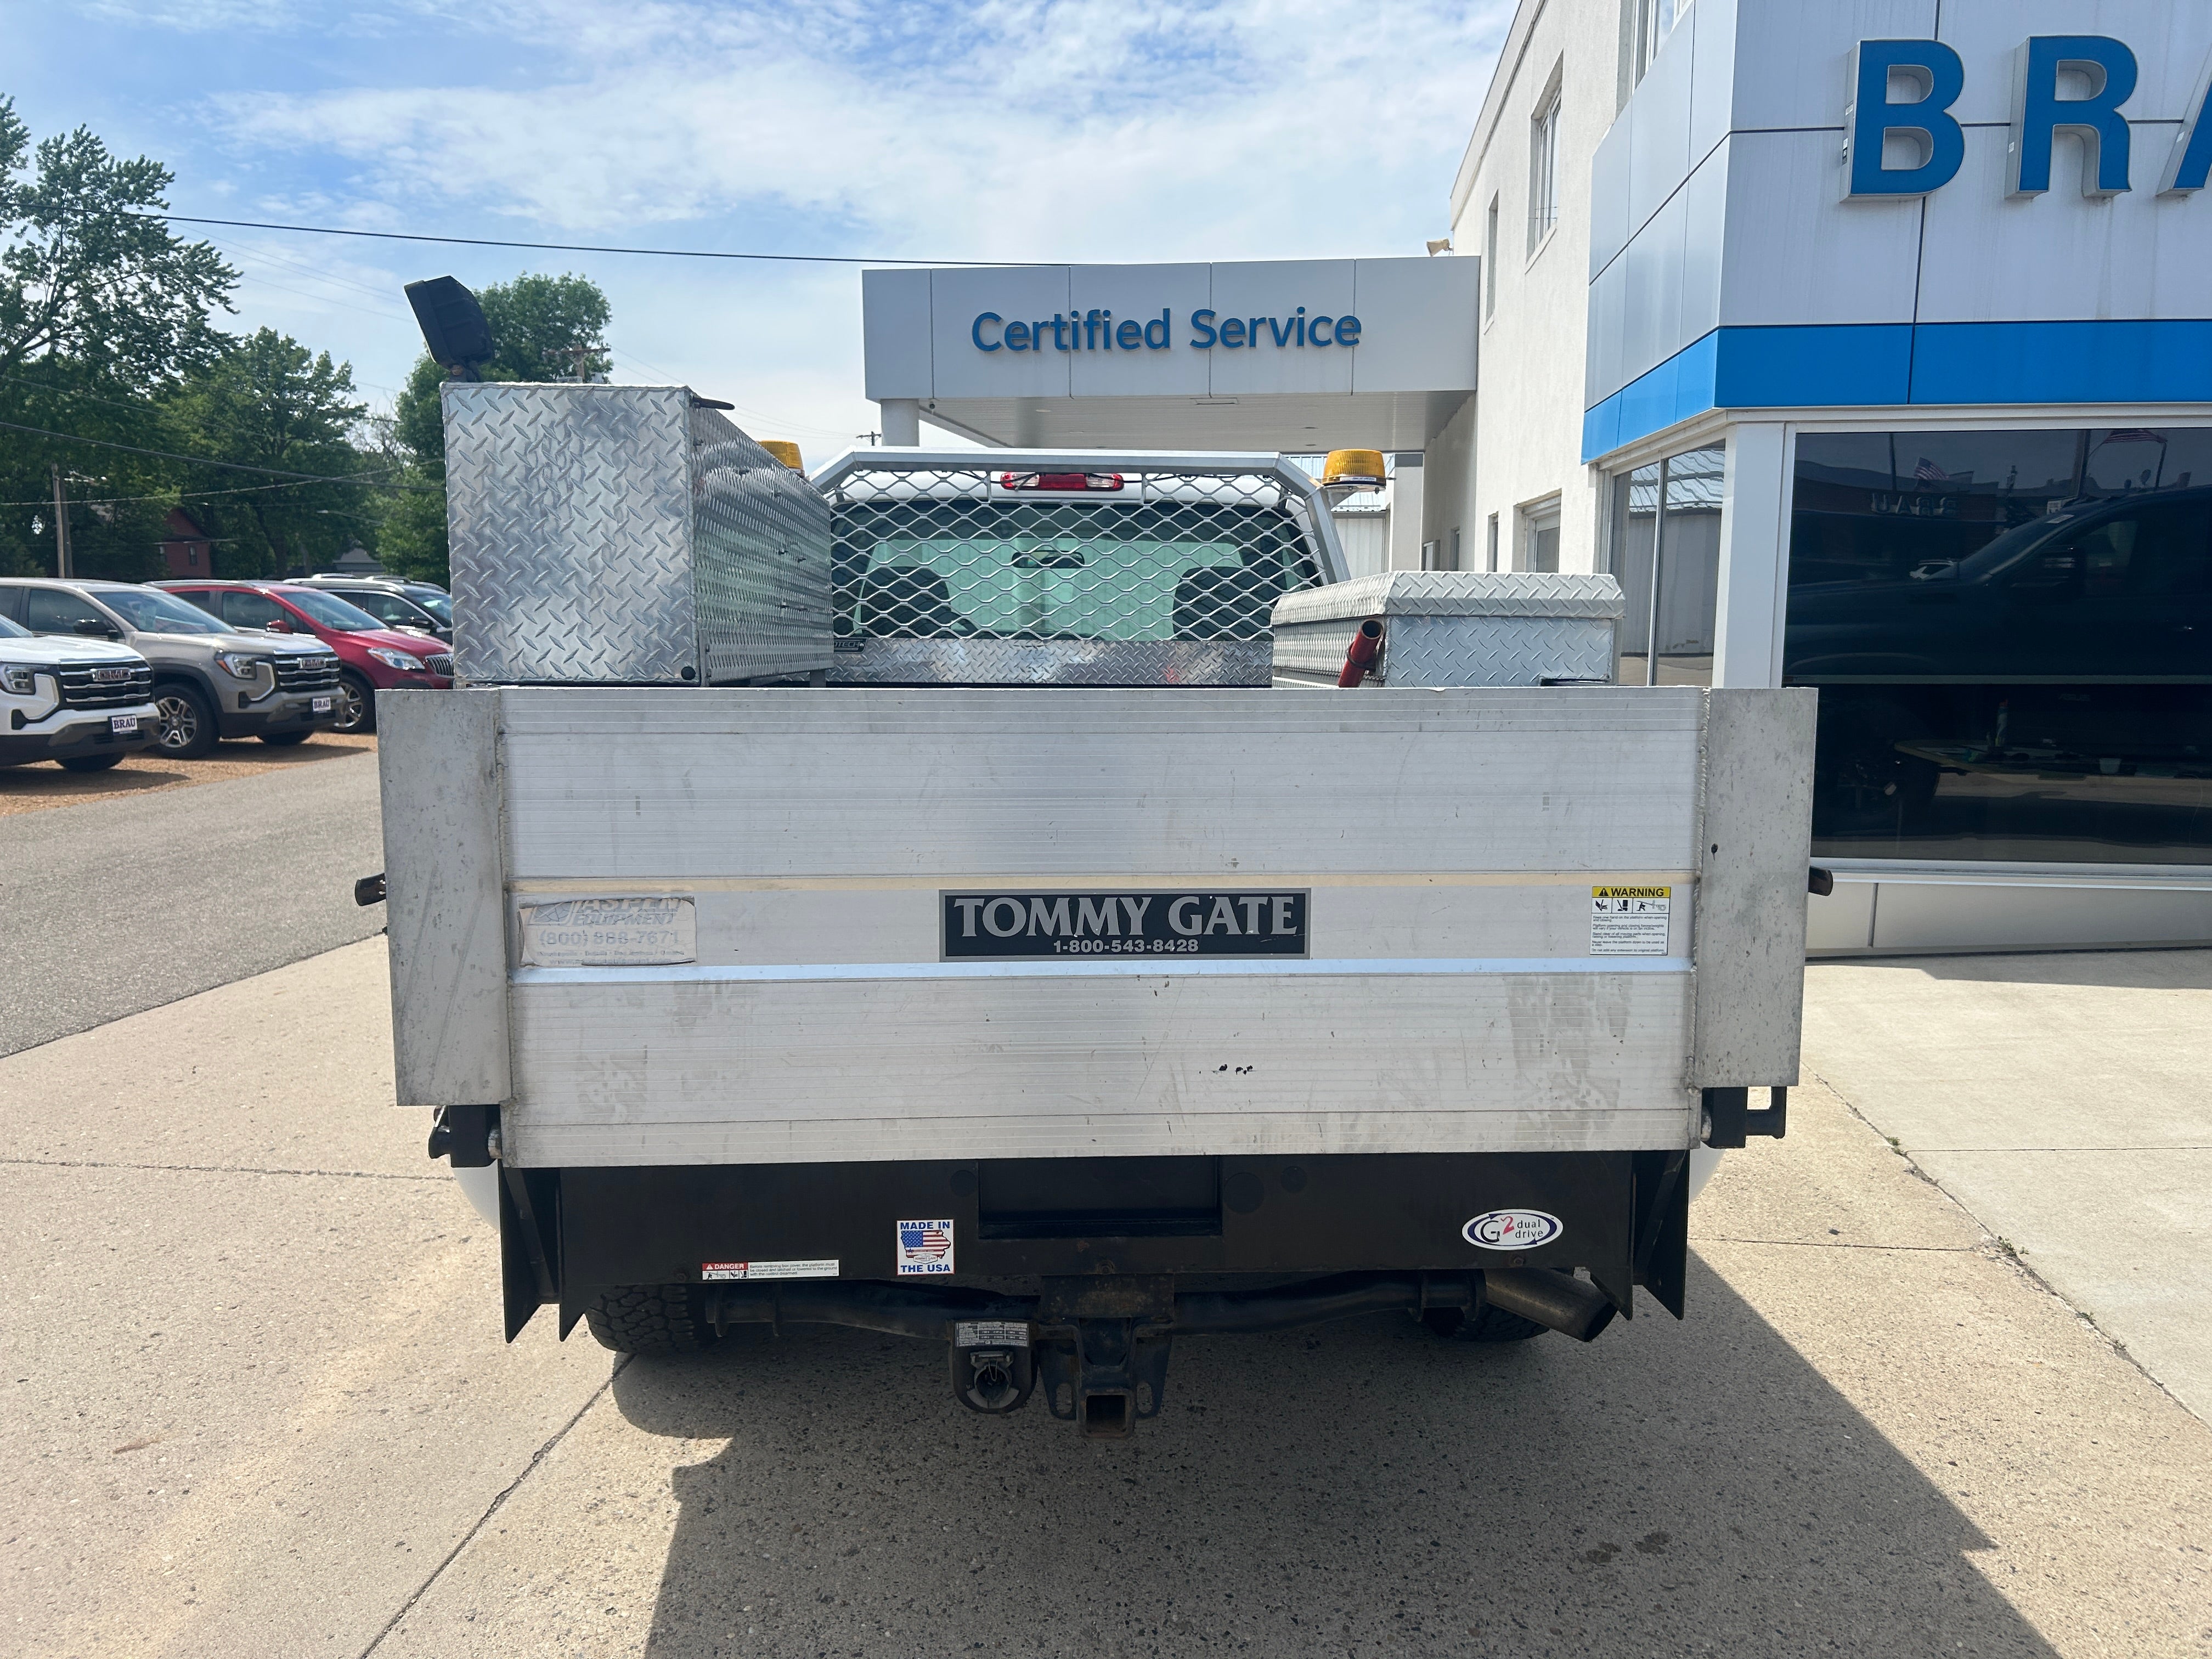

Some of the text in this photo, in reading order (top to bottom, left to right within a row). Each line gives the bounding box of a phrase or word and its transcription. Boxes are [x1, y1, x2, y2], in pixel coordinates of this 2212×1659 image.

[972, 306, 1362, 352] Certified Service
[314, 700, 330, 709] BRAU
[114, 718, 136, 729] BRAU
[1611, 888, 1664, 896] WARNING
[954, 895, 1297, 937] TOMMY GATE
[1053, 939, 1199, 953] 1-800-543-8428
[1517, 1218, 1541, 1229] dual
[1515, 1229, 1544, 1238] drive
